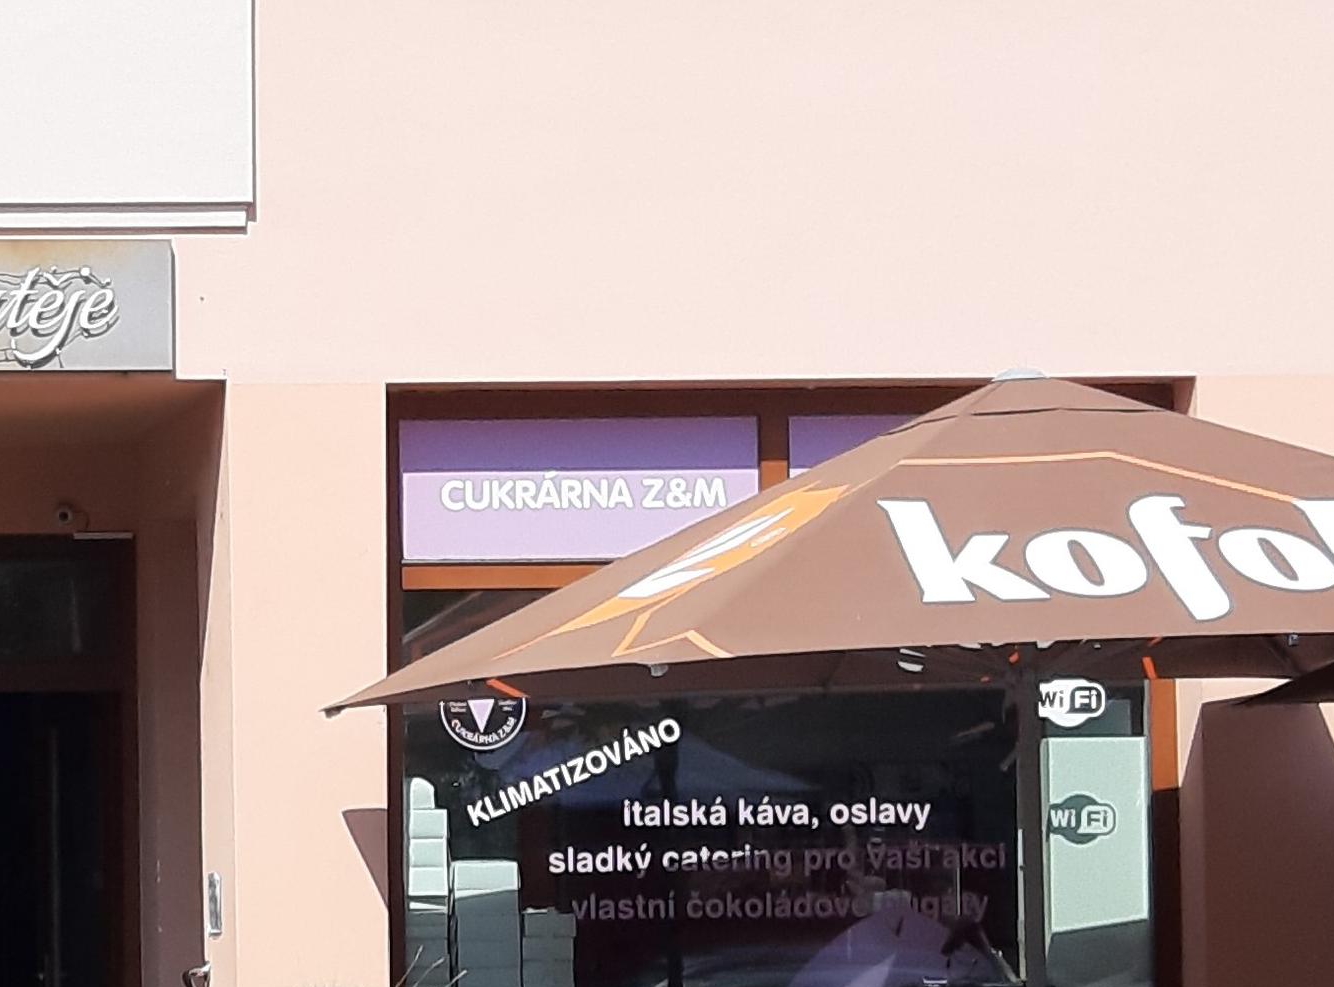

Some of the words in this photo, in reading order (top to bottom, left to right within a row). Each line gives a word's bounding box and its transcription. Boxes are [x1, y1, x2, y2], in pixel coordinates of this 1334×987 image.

[440, 470, 633, 511] CUKRÁRNA
[641, 477, 727, 509] Z&M
[466, 717, 681, 828] KLIMATIZOVÁNO
[623, 796, 726, 827] italská
[738, 796, 818, 829] káva,
[830, 797, 931, 831] oslavy
[548, 843, 652, 879] sladký
[662, 843, 792, 876] catering
[804, 849, 855, 877] pro
[943, 842, 1006, 870] akci
[572, 892, 676, 920] vlastní
